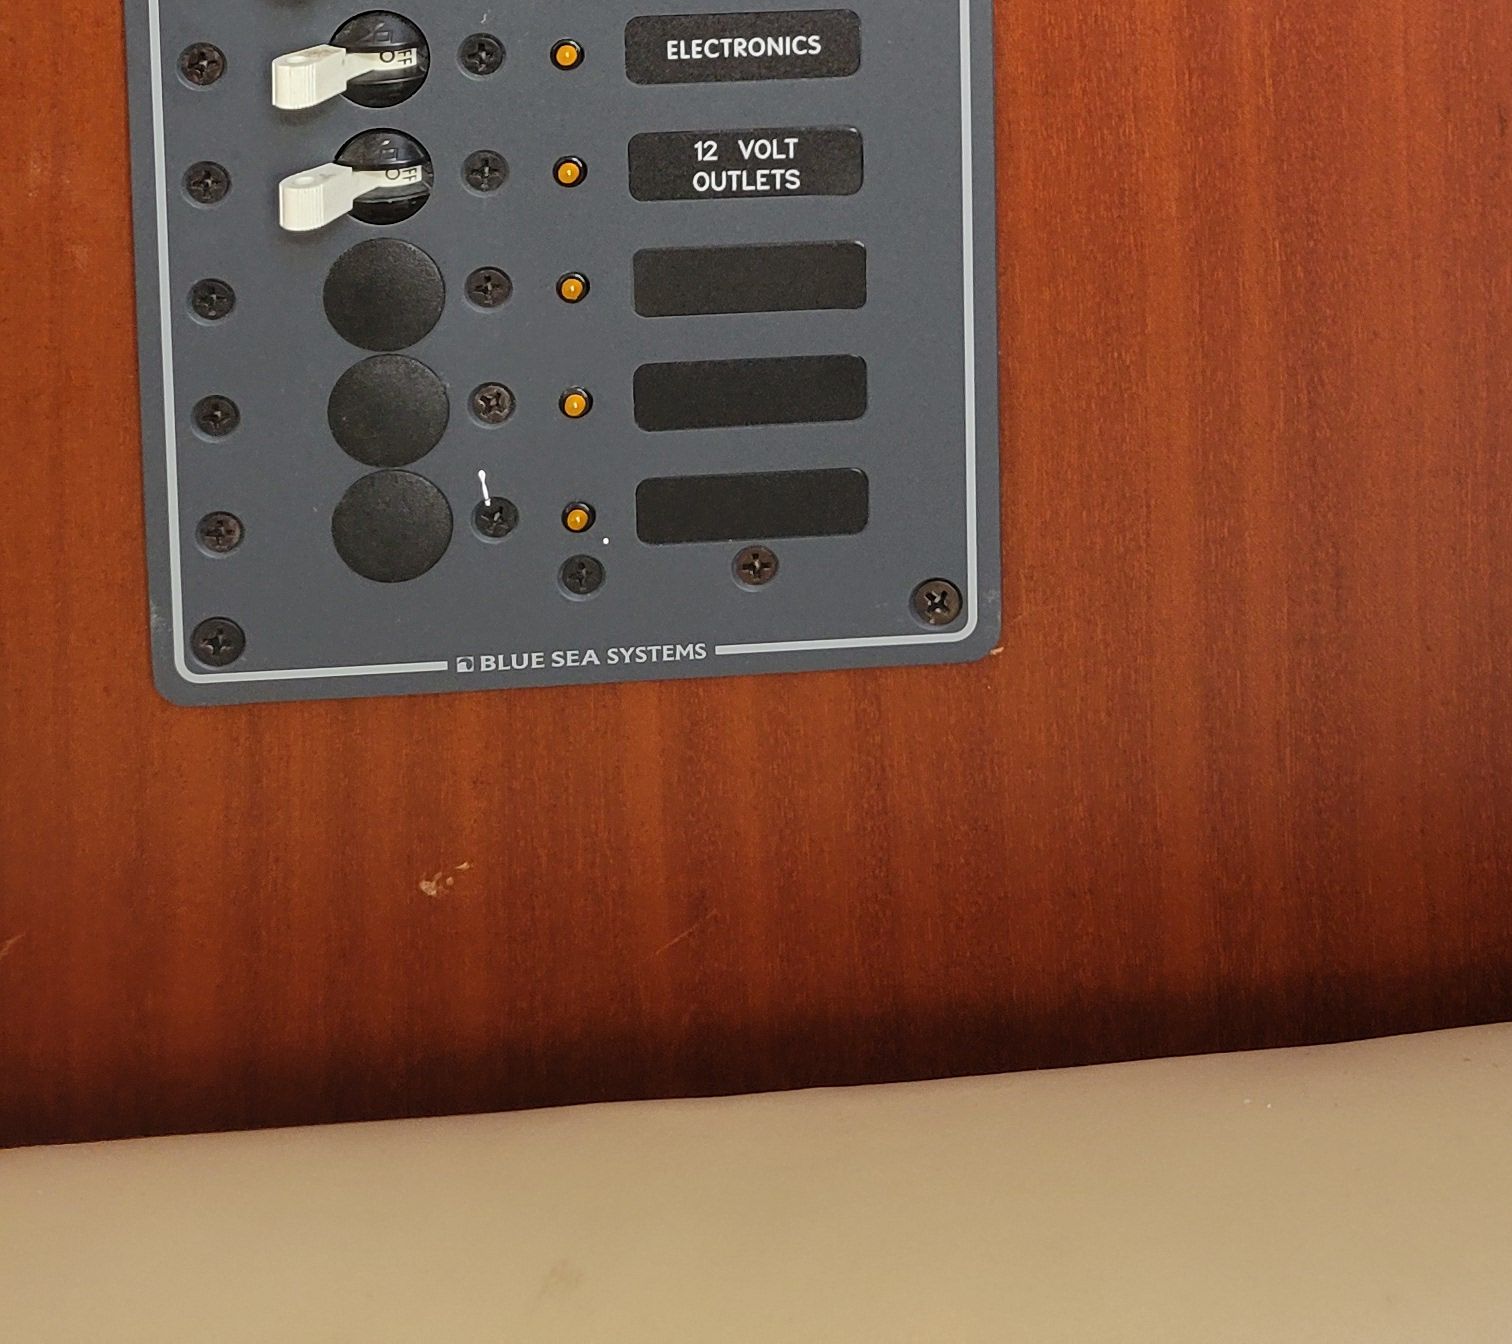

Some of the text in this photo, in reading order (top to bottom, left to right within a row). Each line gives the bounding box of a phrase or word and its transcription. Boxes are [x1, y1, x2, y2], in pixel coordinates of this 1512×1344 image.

[398, 50, 413, 66] FF
[667, 36, 821, 59] ELECTRONICS
[695, 138, 798, 161] 12 VOLT
[404, 168, 418, 182] FF
[693, 169, 800, 191] OUTLETS
[481, 644, 706, 671] BLUE SEA SYSTEMS
